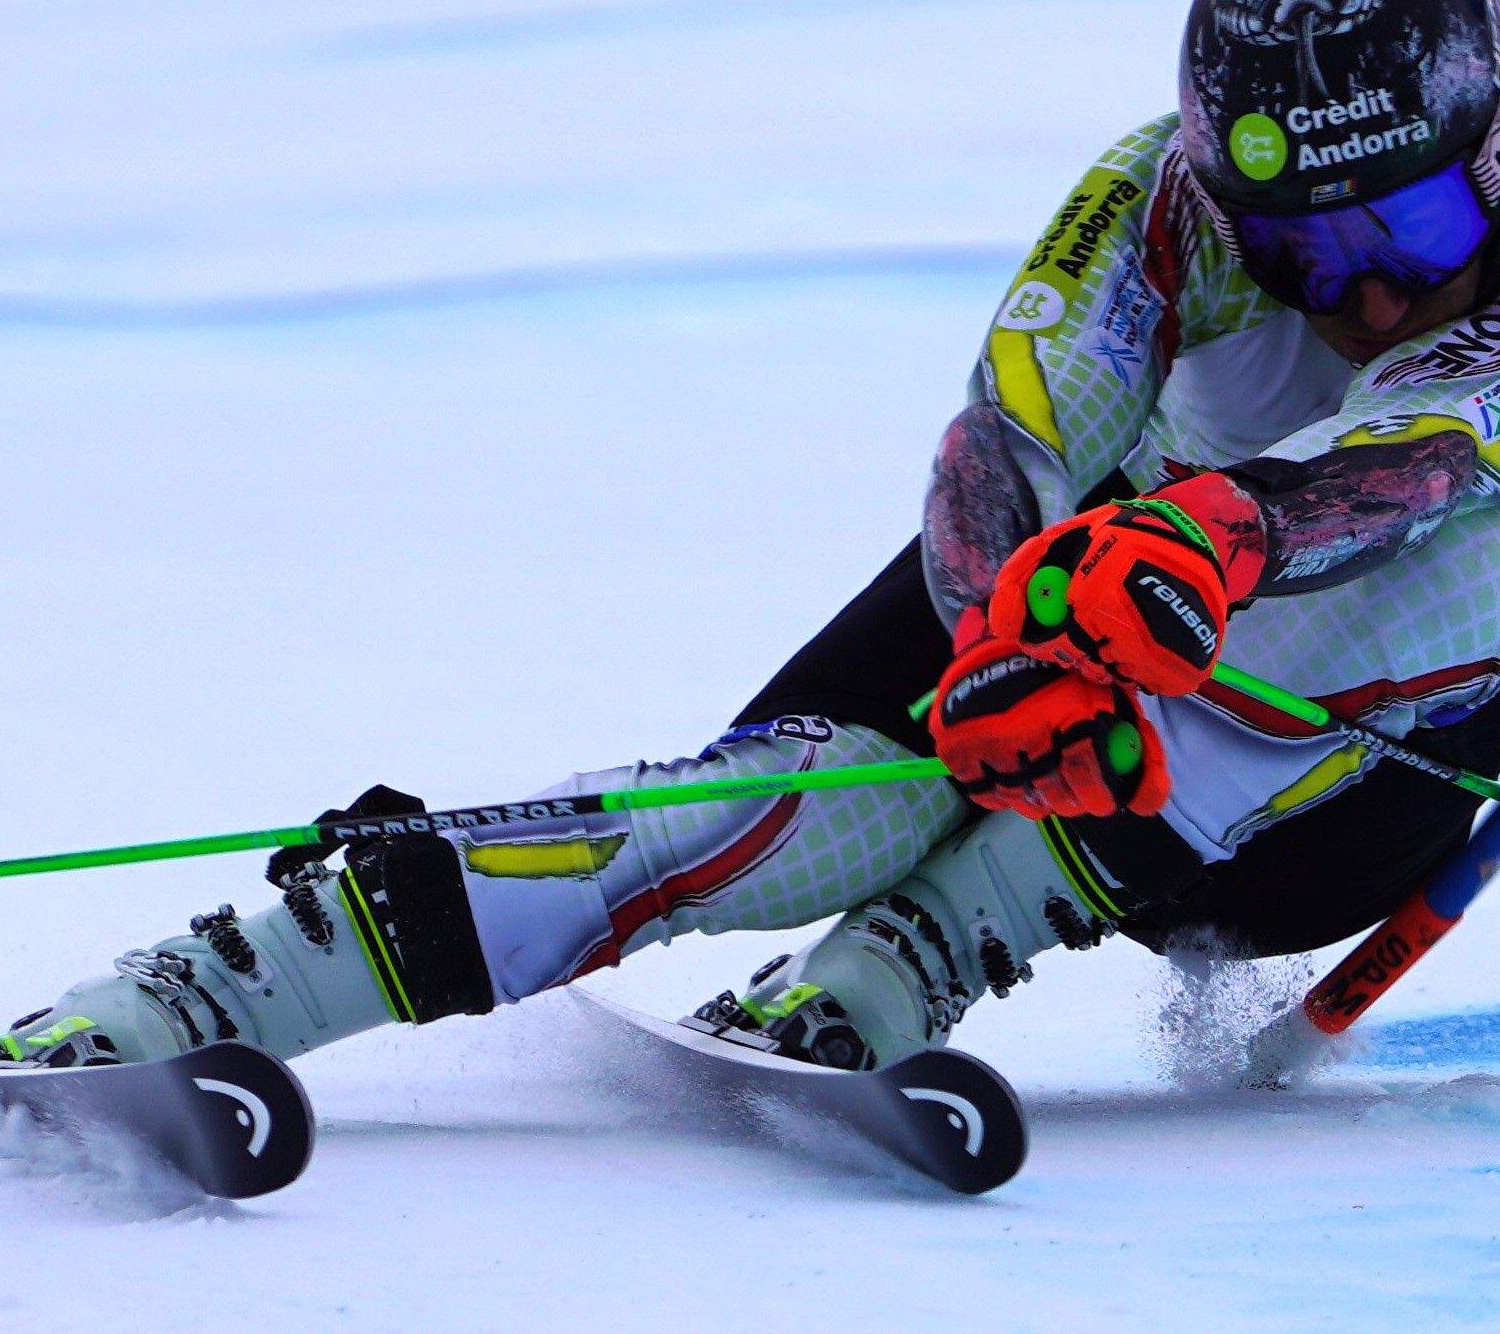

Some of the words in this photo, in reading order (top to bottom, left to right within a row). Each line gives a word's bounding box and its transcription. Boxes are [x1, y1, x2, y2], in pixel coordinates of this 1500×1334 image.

[1286, 87, 1394, 134] Crèdit
[1297, 114, 1431, 171] Andorrà
[1055, 178, 1143, 280] Andorrà
[1137, 574, 1218, 656] reusch
[333, 799, 577, 840] KOMPERDELL
